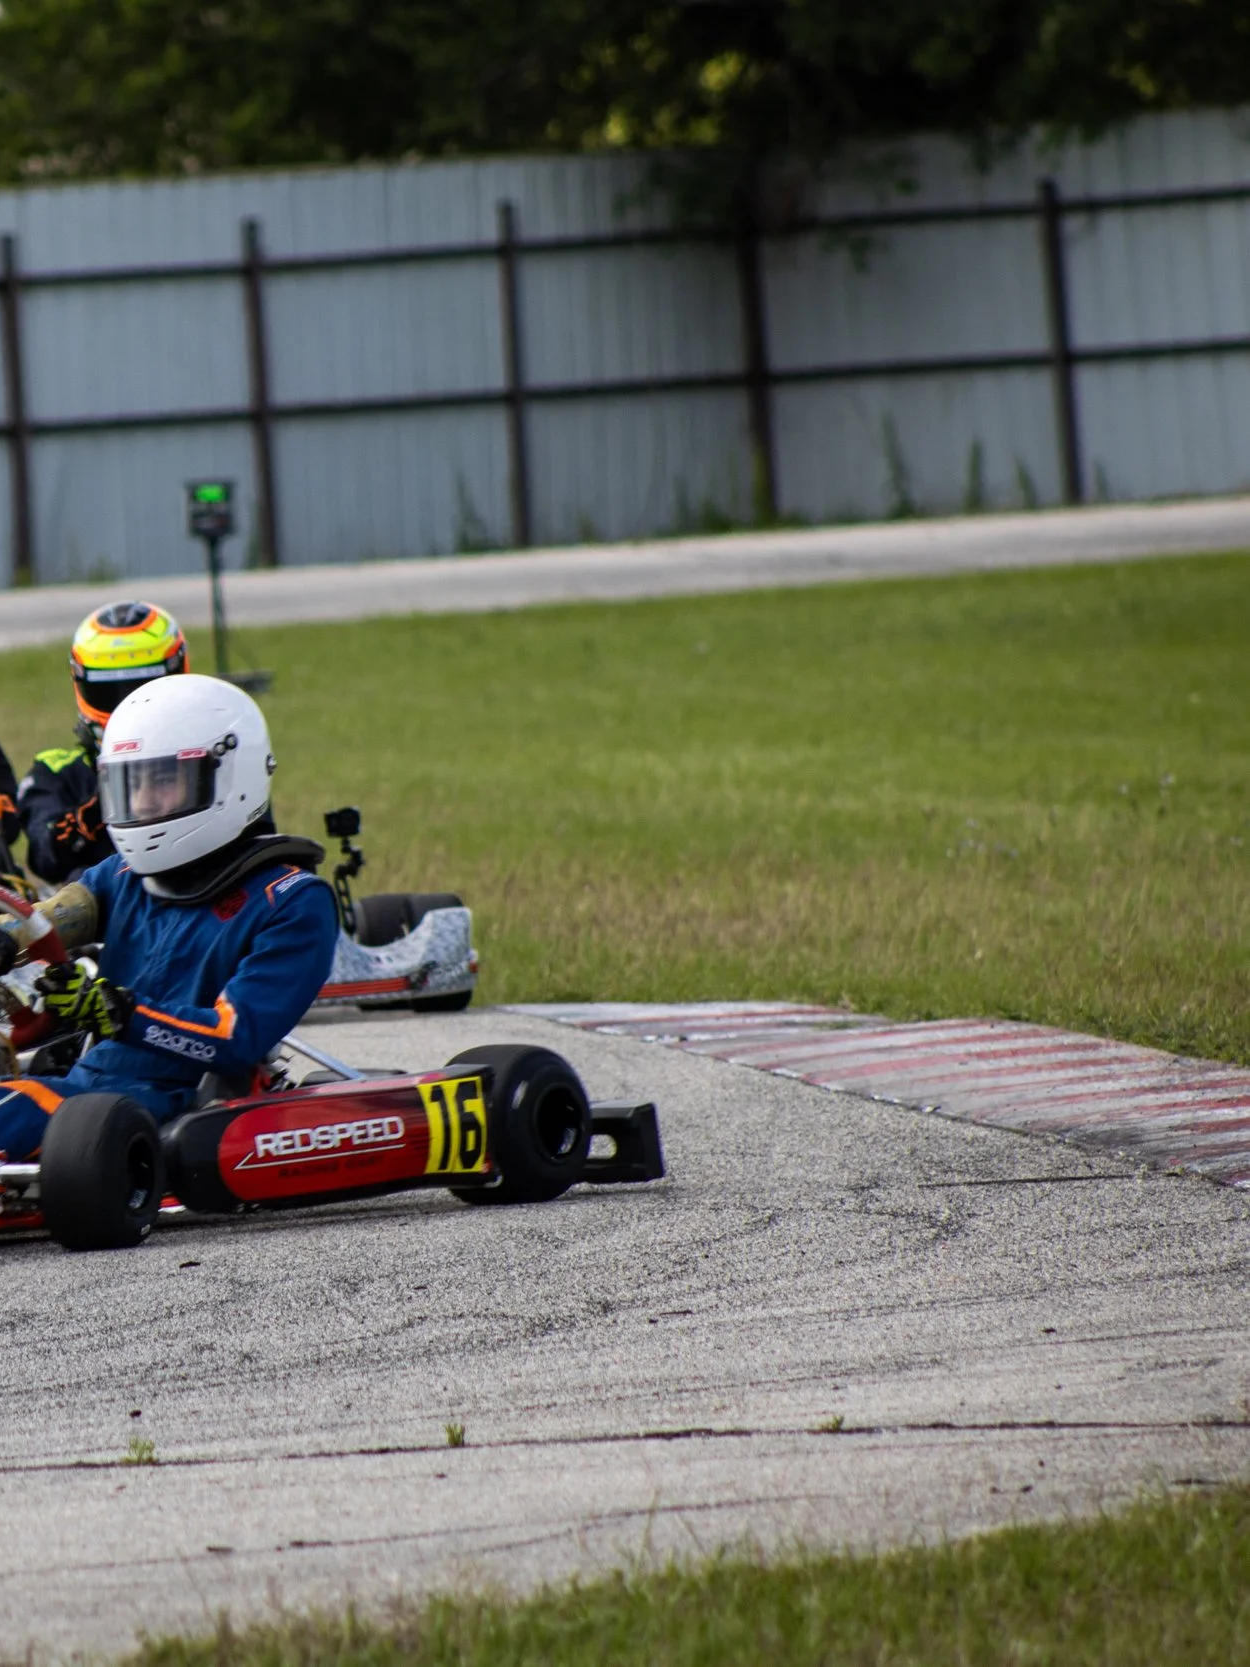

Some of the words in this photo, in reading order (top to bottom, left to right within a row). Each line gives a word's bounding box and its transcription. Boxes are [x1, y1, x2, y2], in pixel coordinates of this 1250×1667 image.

[144, 1025, 217, 1062] sparco
[254, 1116, 405, 1158] REDSPEED
[430, 1080, 482, 1171] 16
